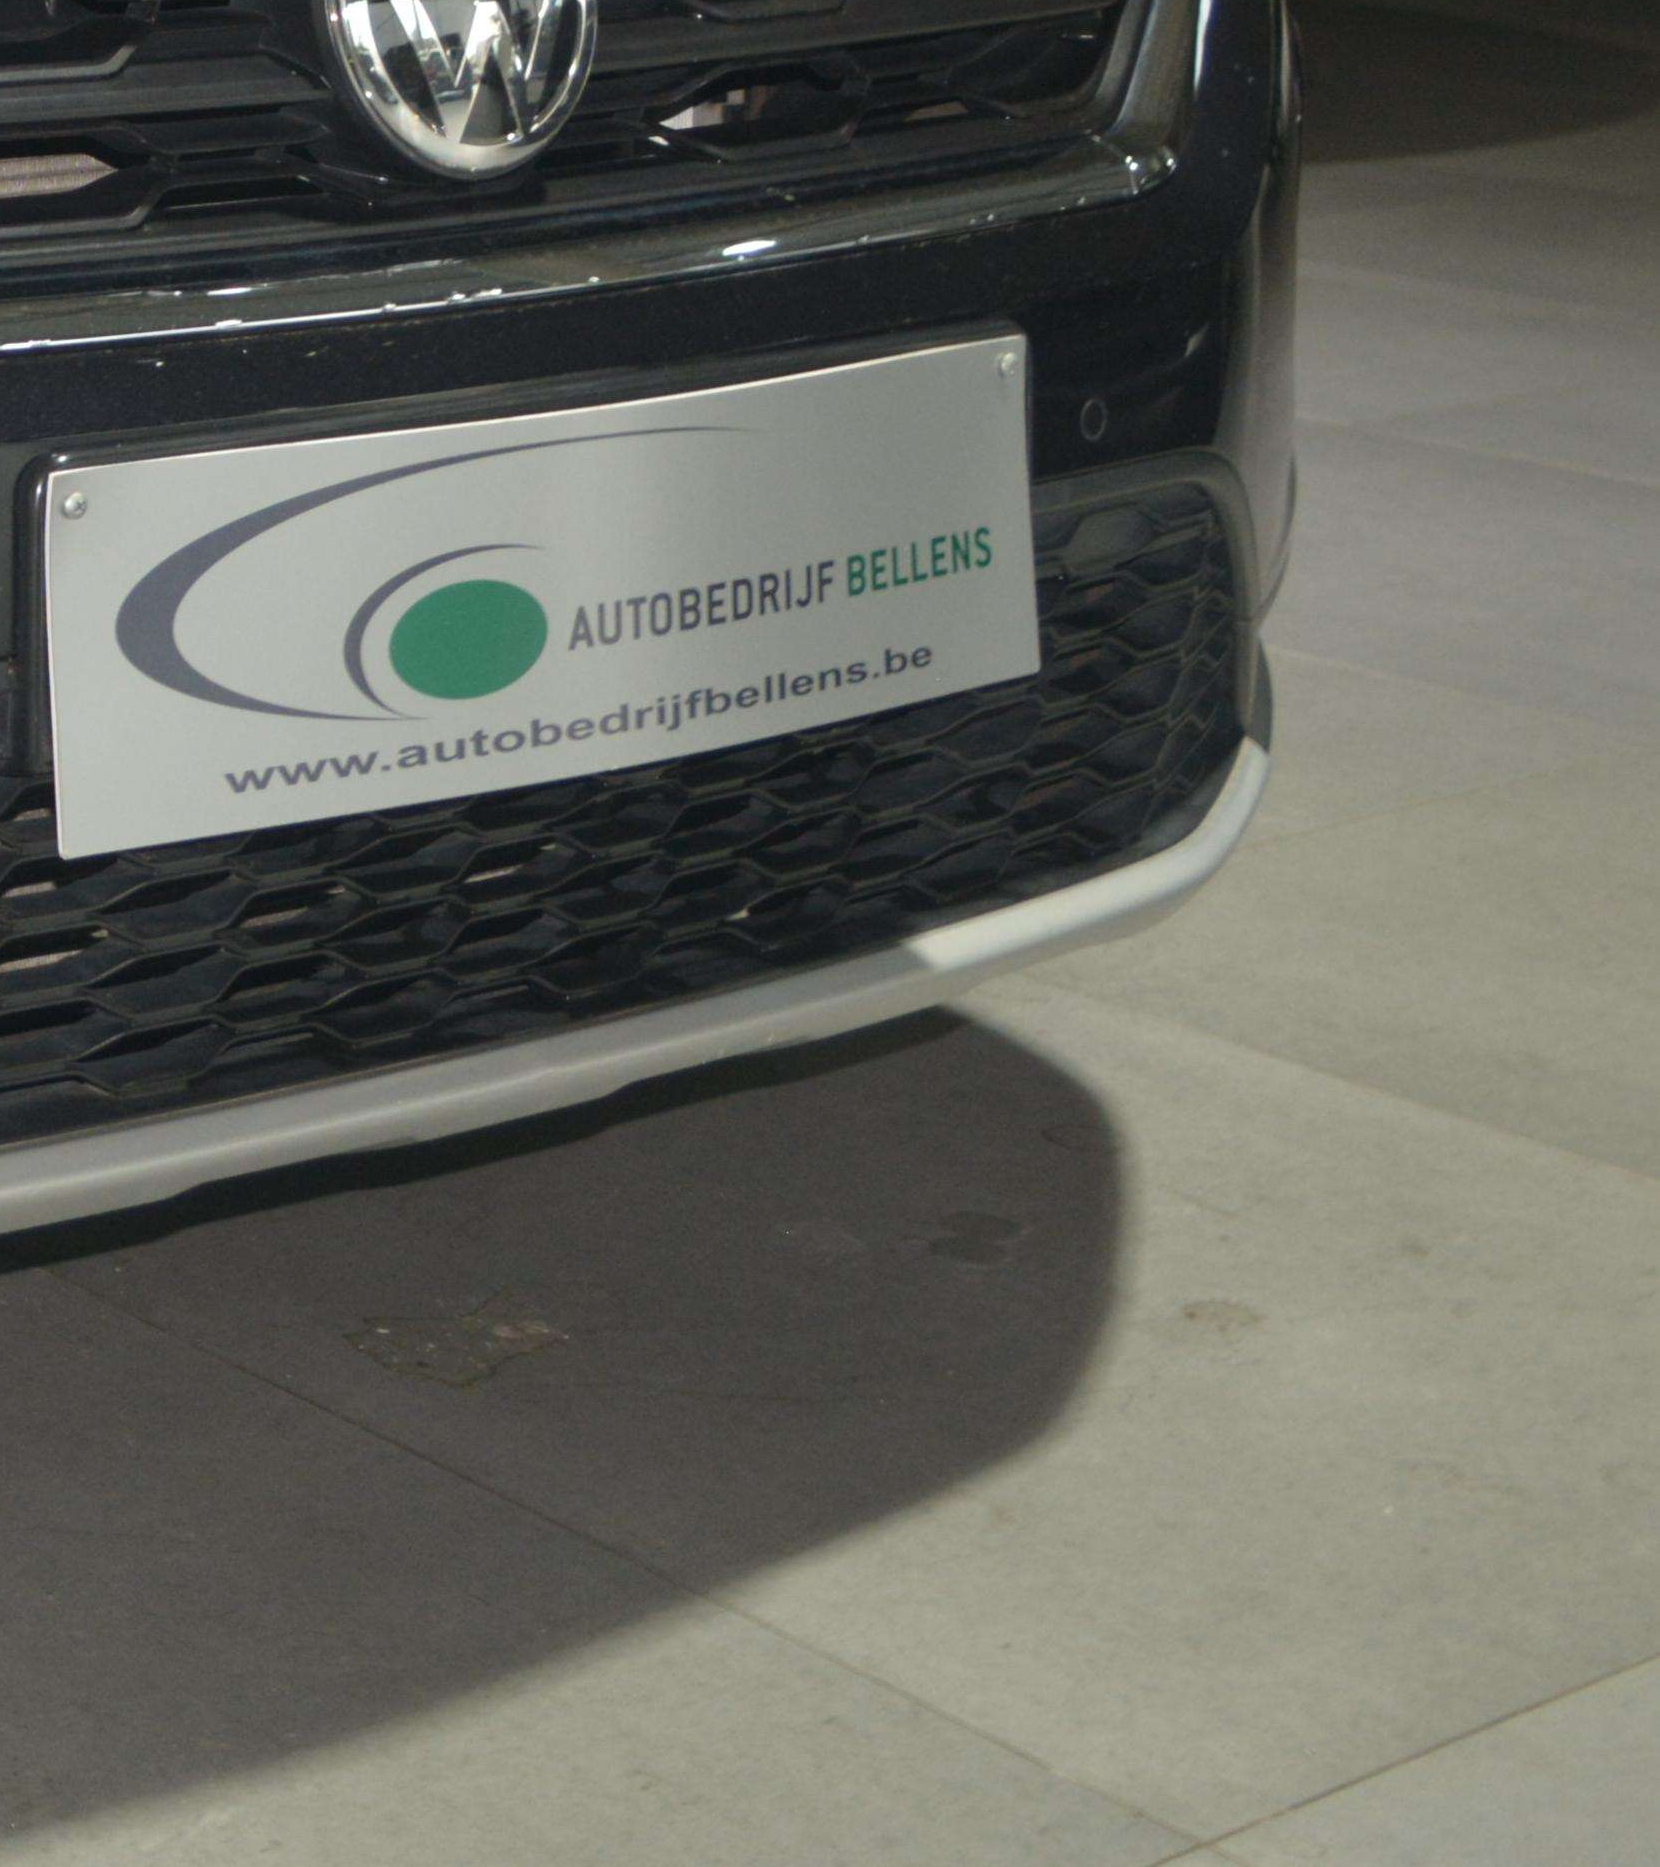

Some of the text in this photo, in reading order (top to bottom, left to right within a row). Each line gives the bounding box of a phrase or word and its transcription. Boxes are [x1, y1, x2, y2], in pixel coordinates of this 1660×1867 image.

[567, 526, 994, 652] AUTOBEDRIJF BELLENS
[224, 644, 934, 796] www.autobedrijfbellens.be
